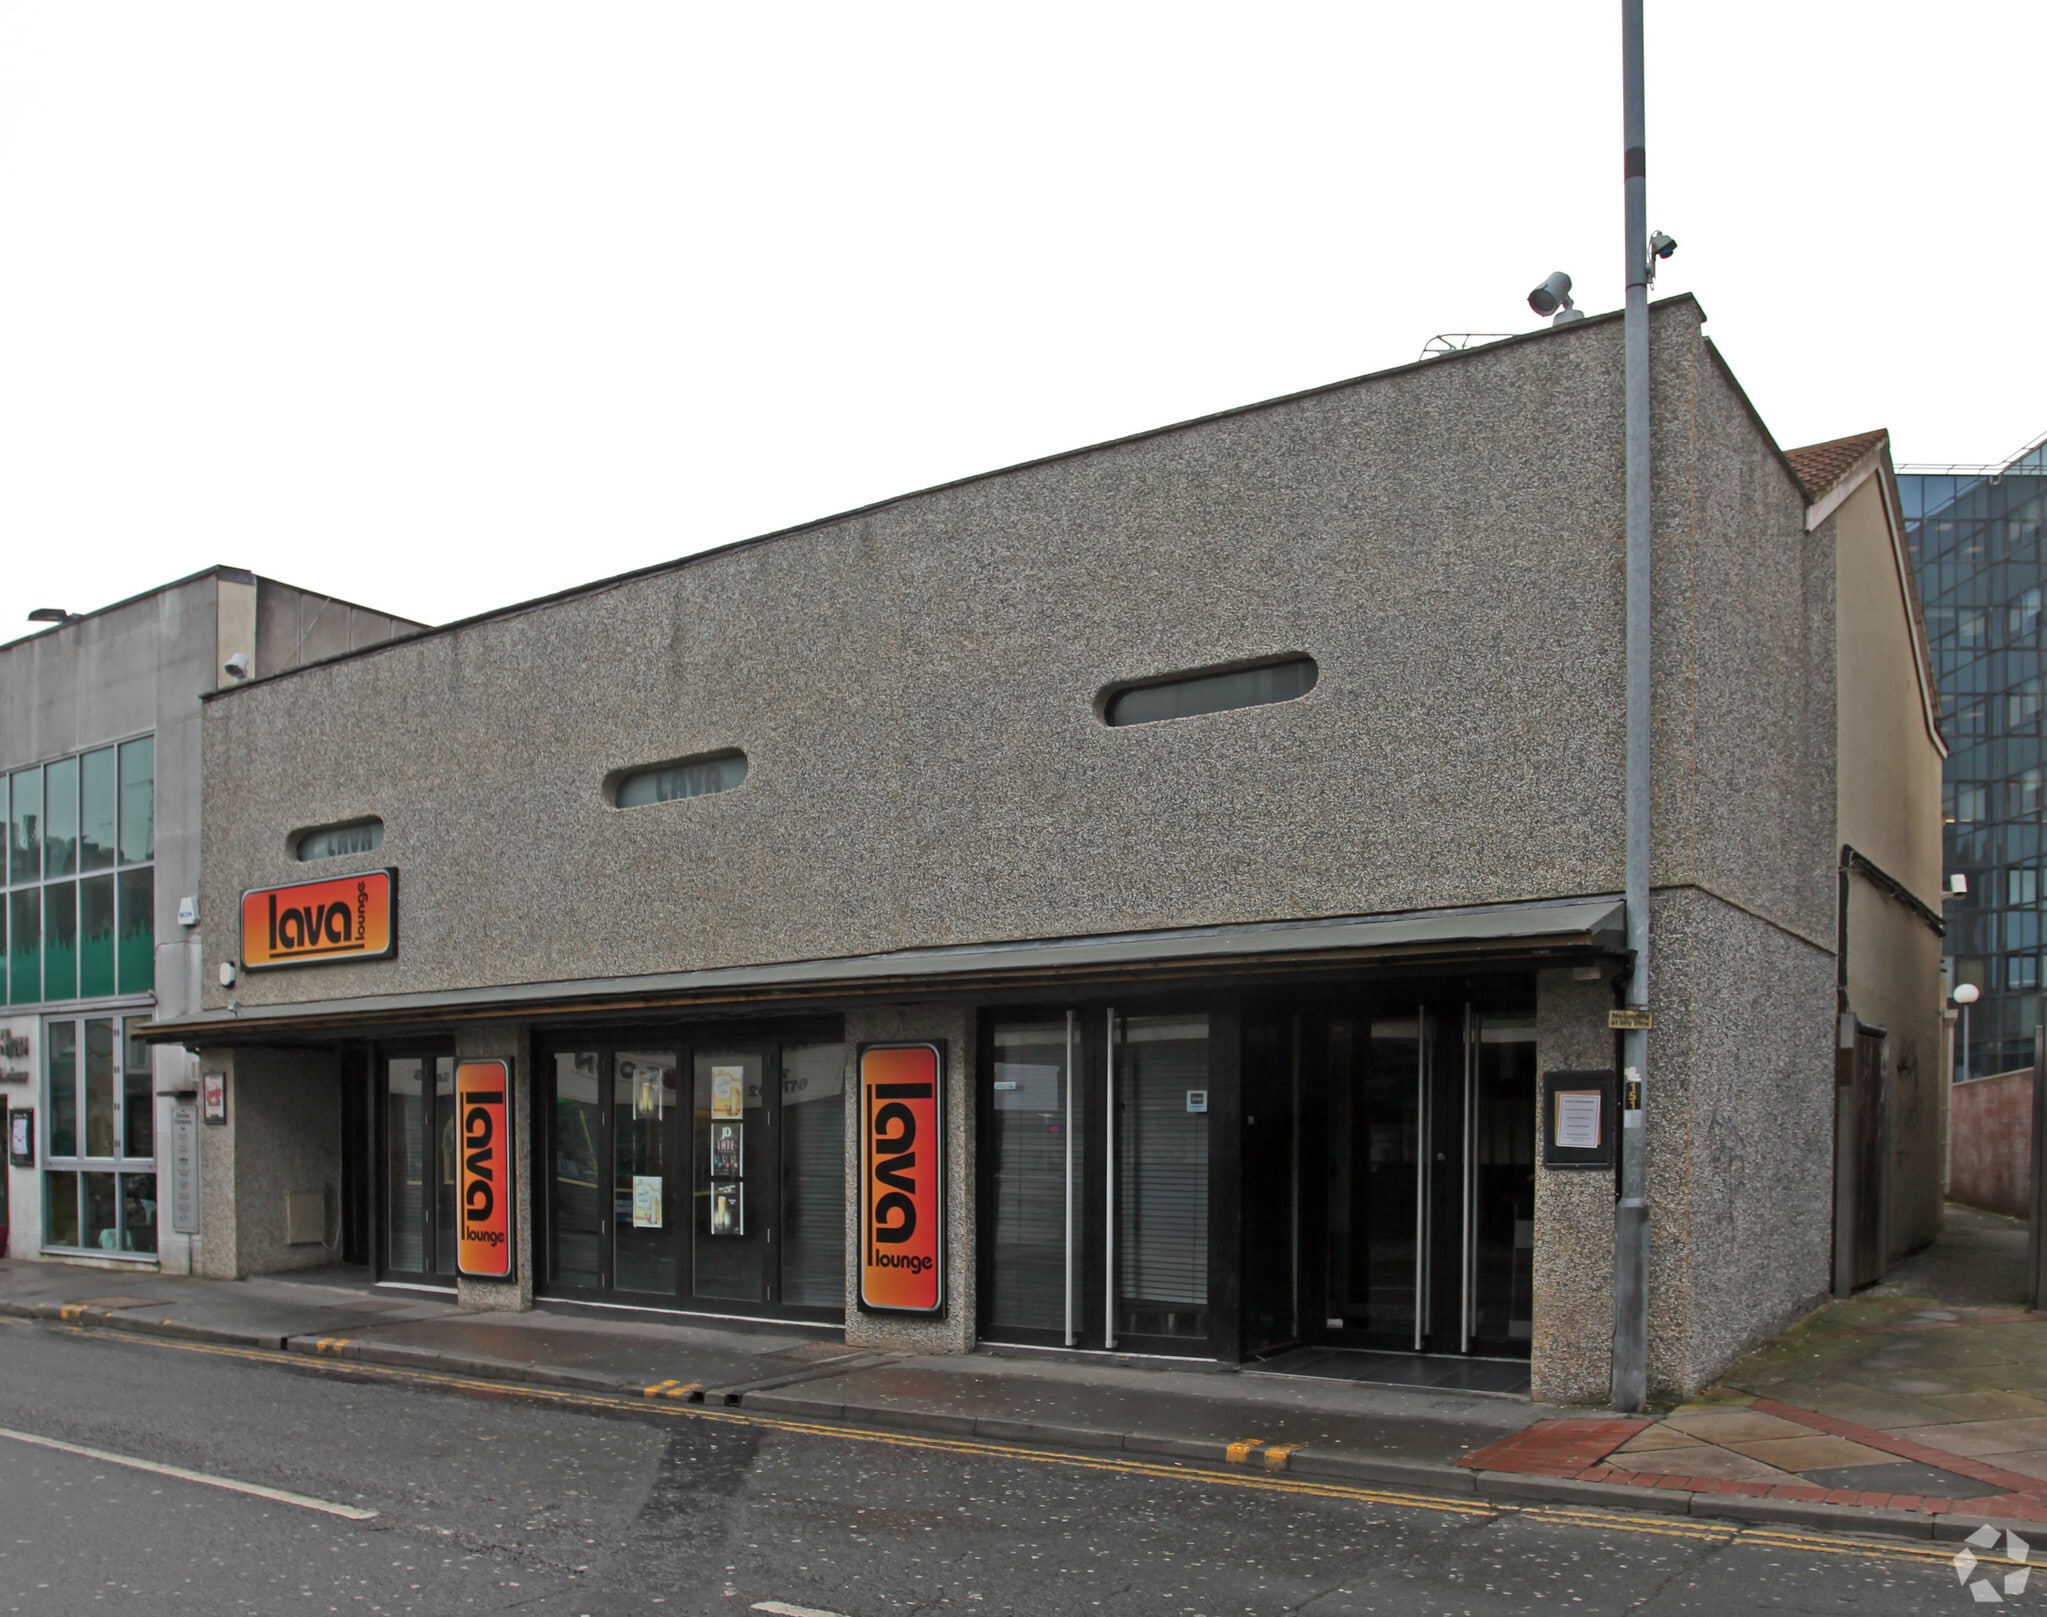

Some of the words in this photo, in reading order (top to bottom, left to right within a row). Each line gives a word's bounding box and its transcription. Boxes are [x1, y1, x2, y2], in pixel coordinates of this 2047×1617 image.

[268, 894, 352, 950] lava
[355, 881, 368, 941] lounge
[465, 1091, 504, 1222] lava
[874, 1083, 933, 1244] lava
[466, 1226, 505, 1247] lounge
[875, 1248, 932, 1275] lounge
